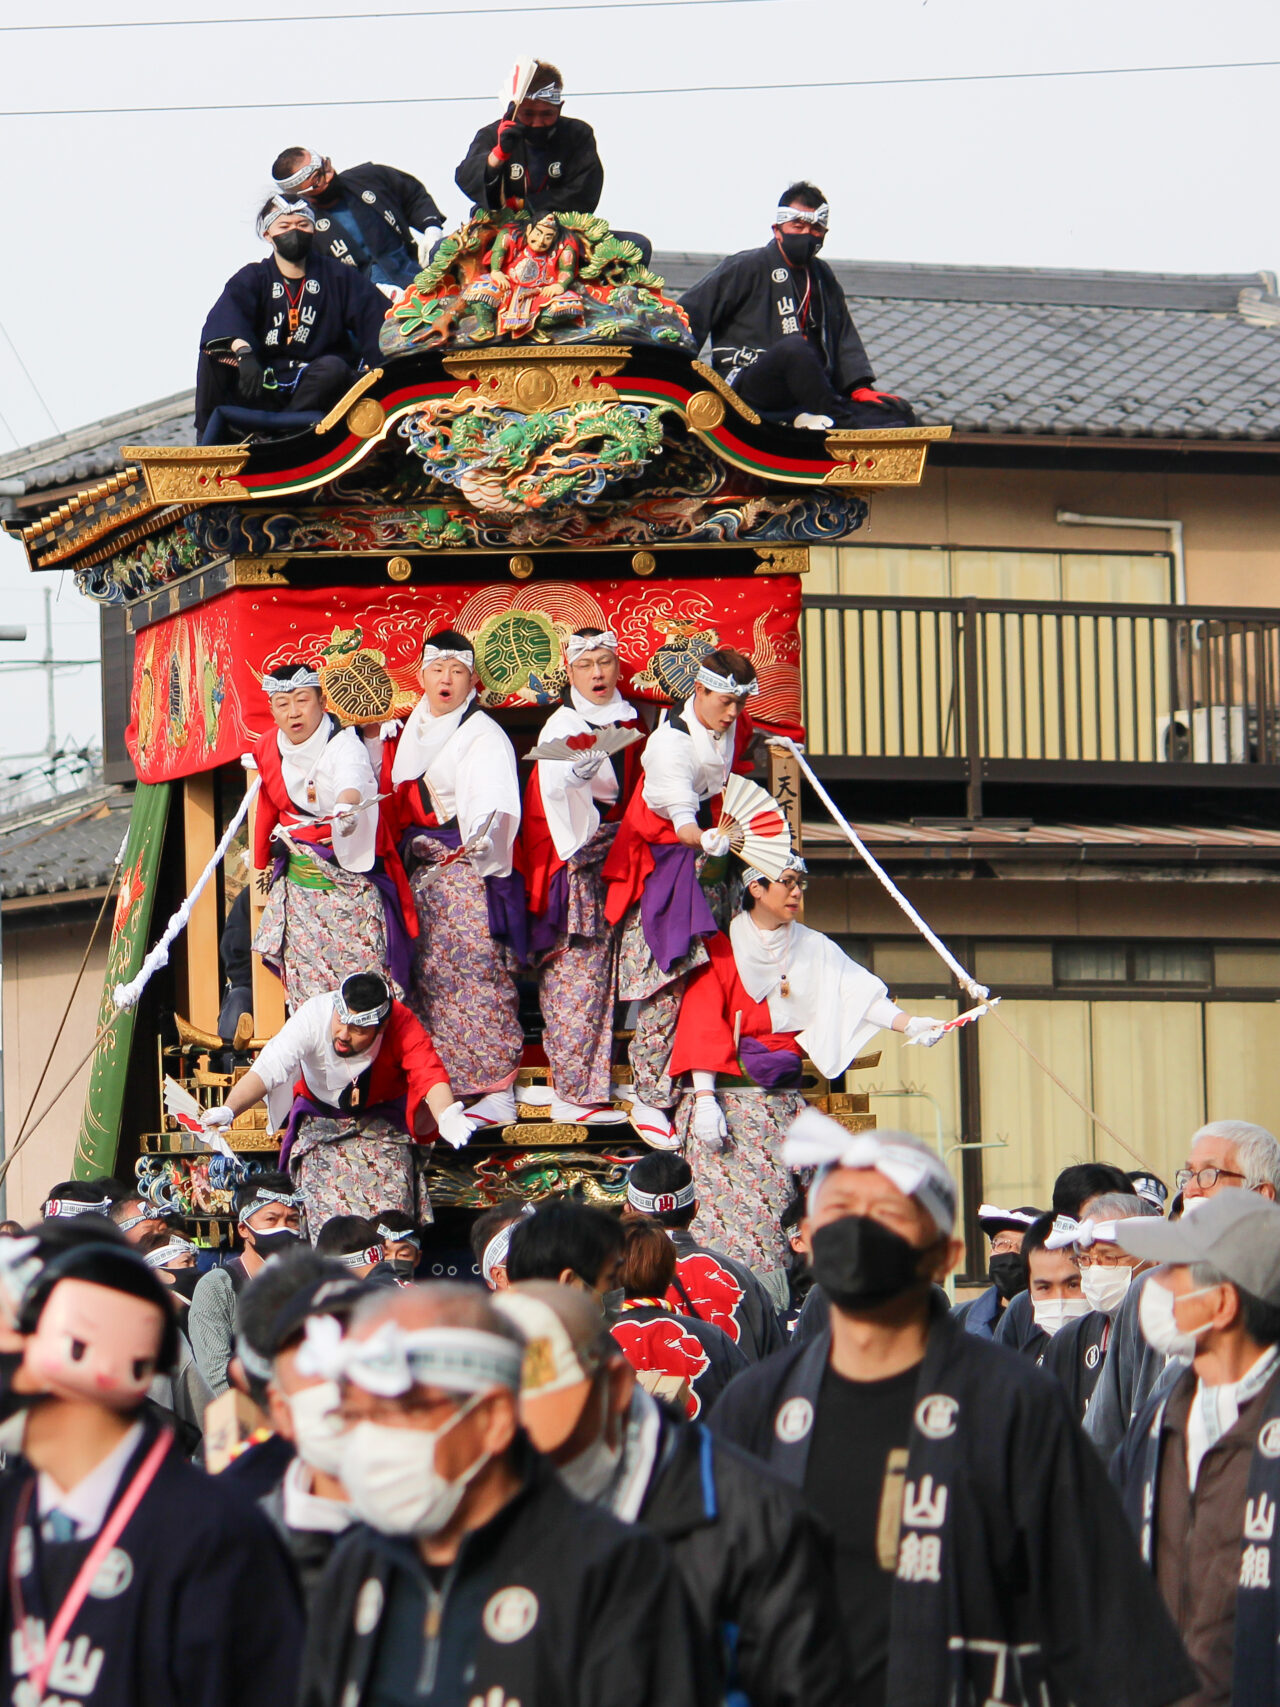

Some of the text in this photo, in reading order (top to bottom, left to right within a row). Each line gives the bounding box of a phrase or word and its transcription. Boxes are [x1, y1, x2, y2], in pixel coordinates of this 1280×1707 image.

[293, 305, 316, 344] 山組
[777, 296, 799, 335] 山組
[897, 1474, 948, 1583] 山組
[1239, 1492, 1276, 1589] 山組
